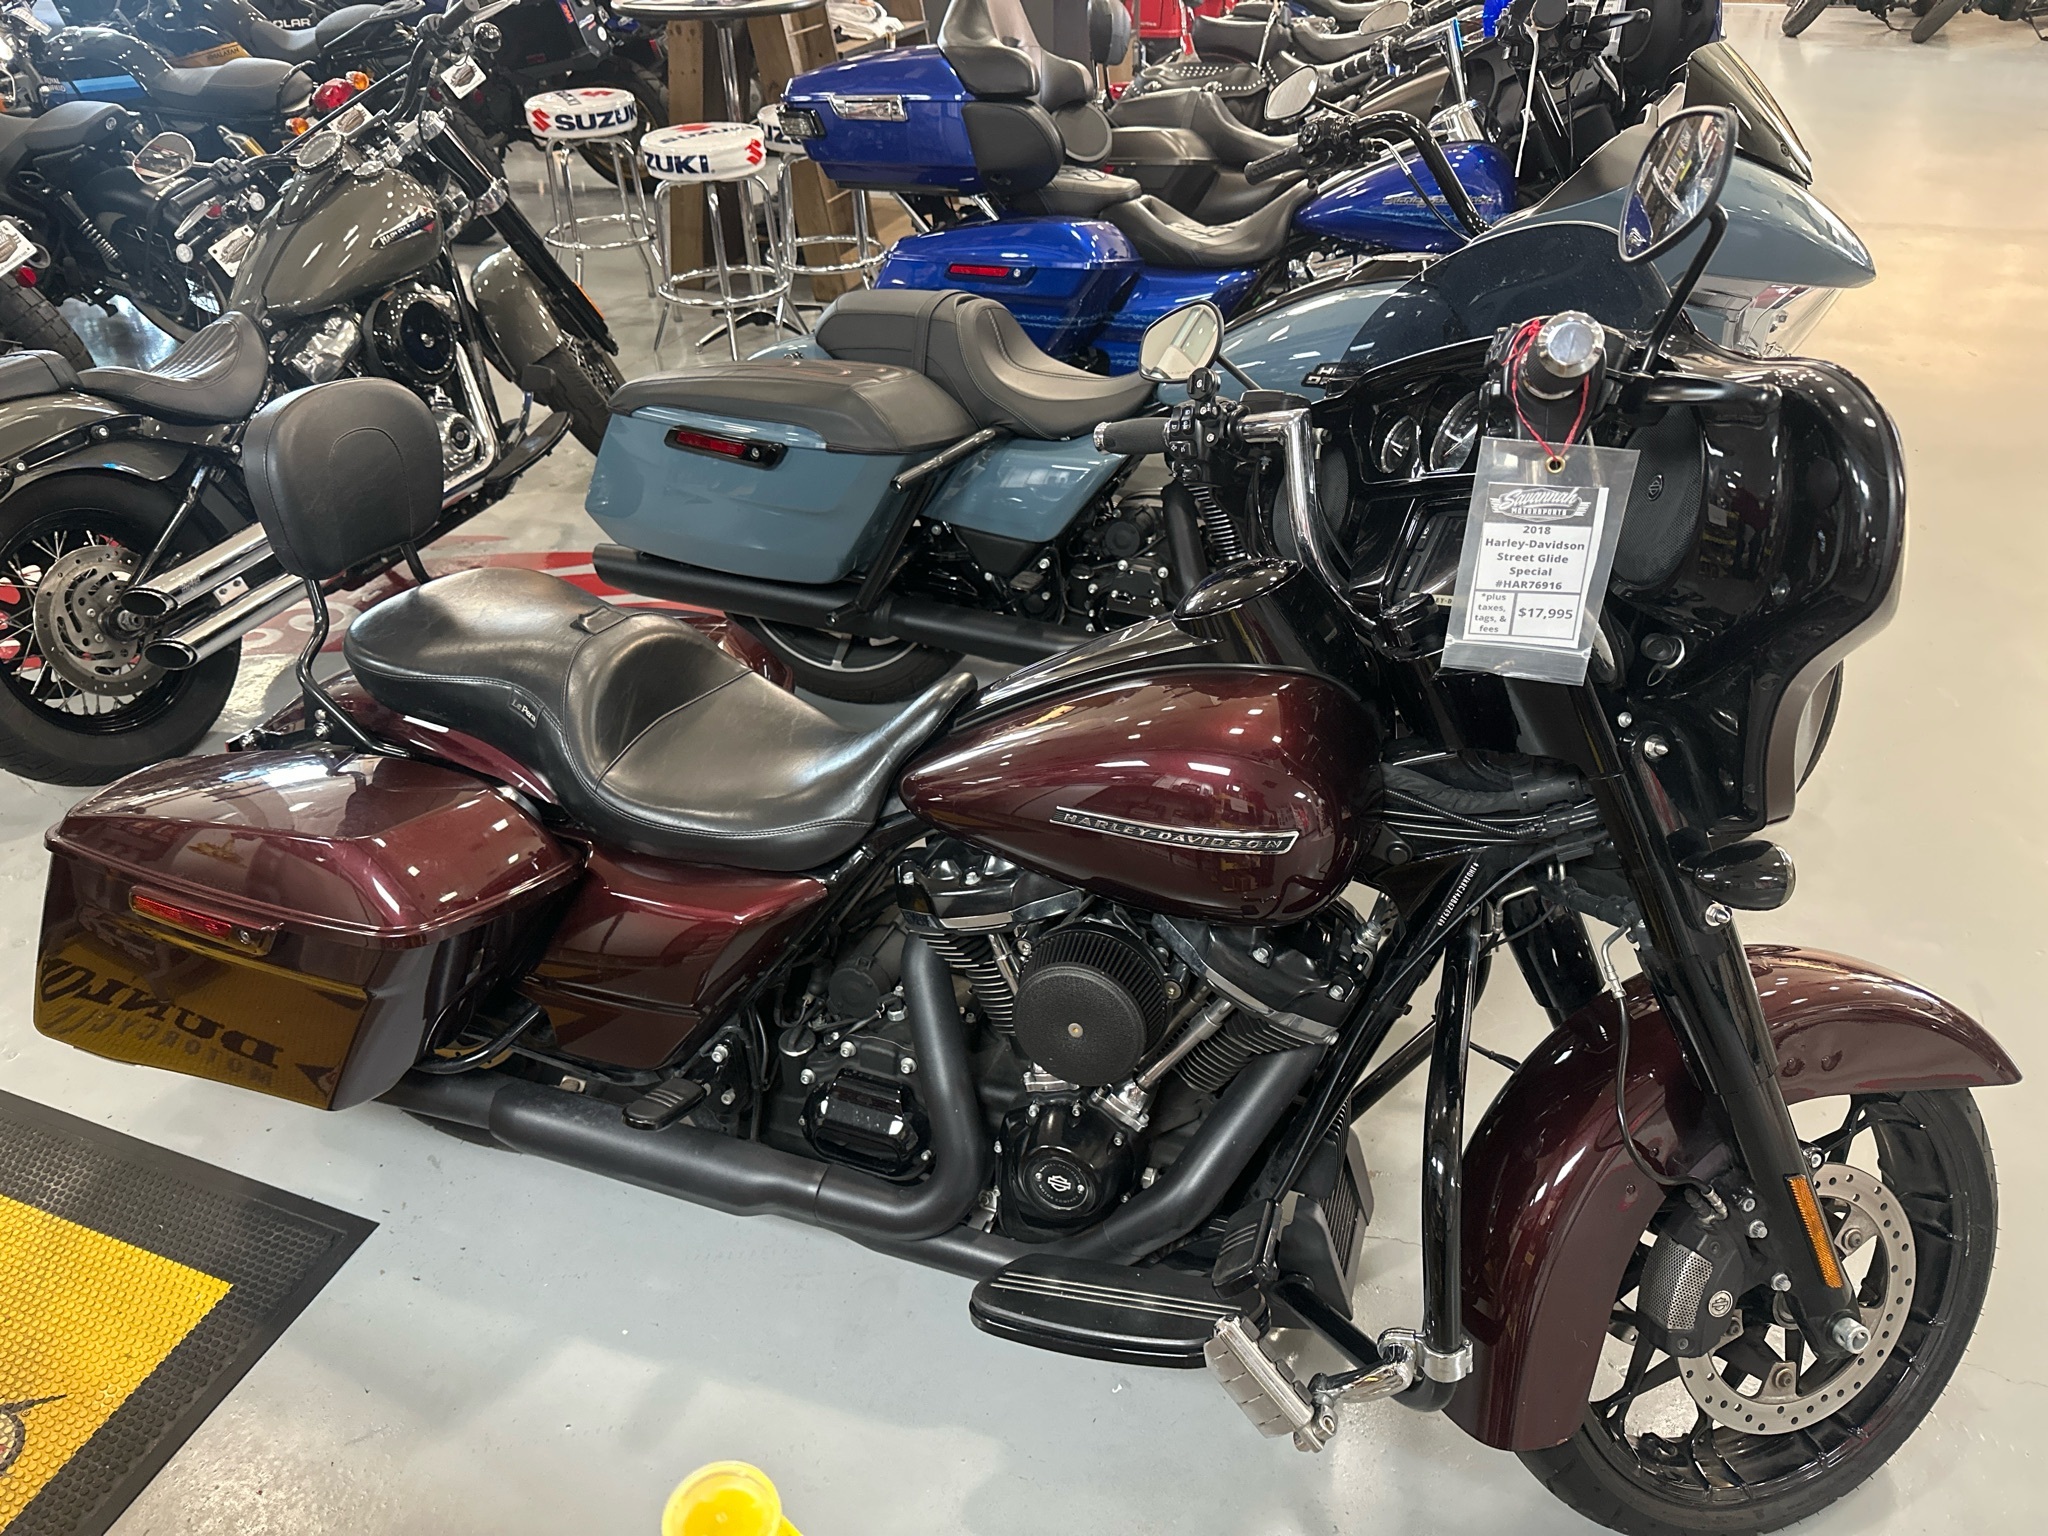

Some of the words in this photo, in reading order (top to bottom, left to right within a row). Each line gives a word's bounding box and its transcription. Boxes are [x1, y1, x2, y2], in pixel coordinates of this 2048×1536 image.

[1498, 487, 1580, 511] Savannah
[1511, 507, 1567, 516] MOTORSPORTS
[1523, 525, 1551, 535] 2018
[1485, 538, 1585, 551] Harley-Davidson
[1497, 552, 1535, 562] Street
[1538, 553, 1569, 564] Glide
[1509, 566, 1552, 578] Special
[1495, 580, 1562, 590] #HAR76916
[1478, 604, 1506, 613] taxes,
[1518, 607, 1573, 620] $17,995
[1474, 614, 1497, 624] tags,
[1499, 615, 1507, 623] &
[1479, 624, 1499, 633] fees
[1063, 812, 1283, 849] HARLEY-DAVIDSON
